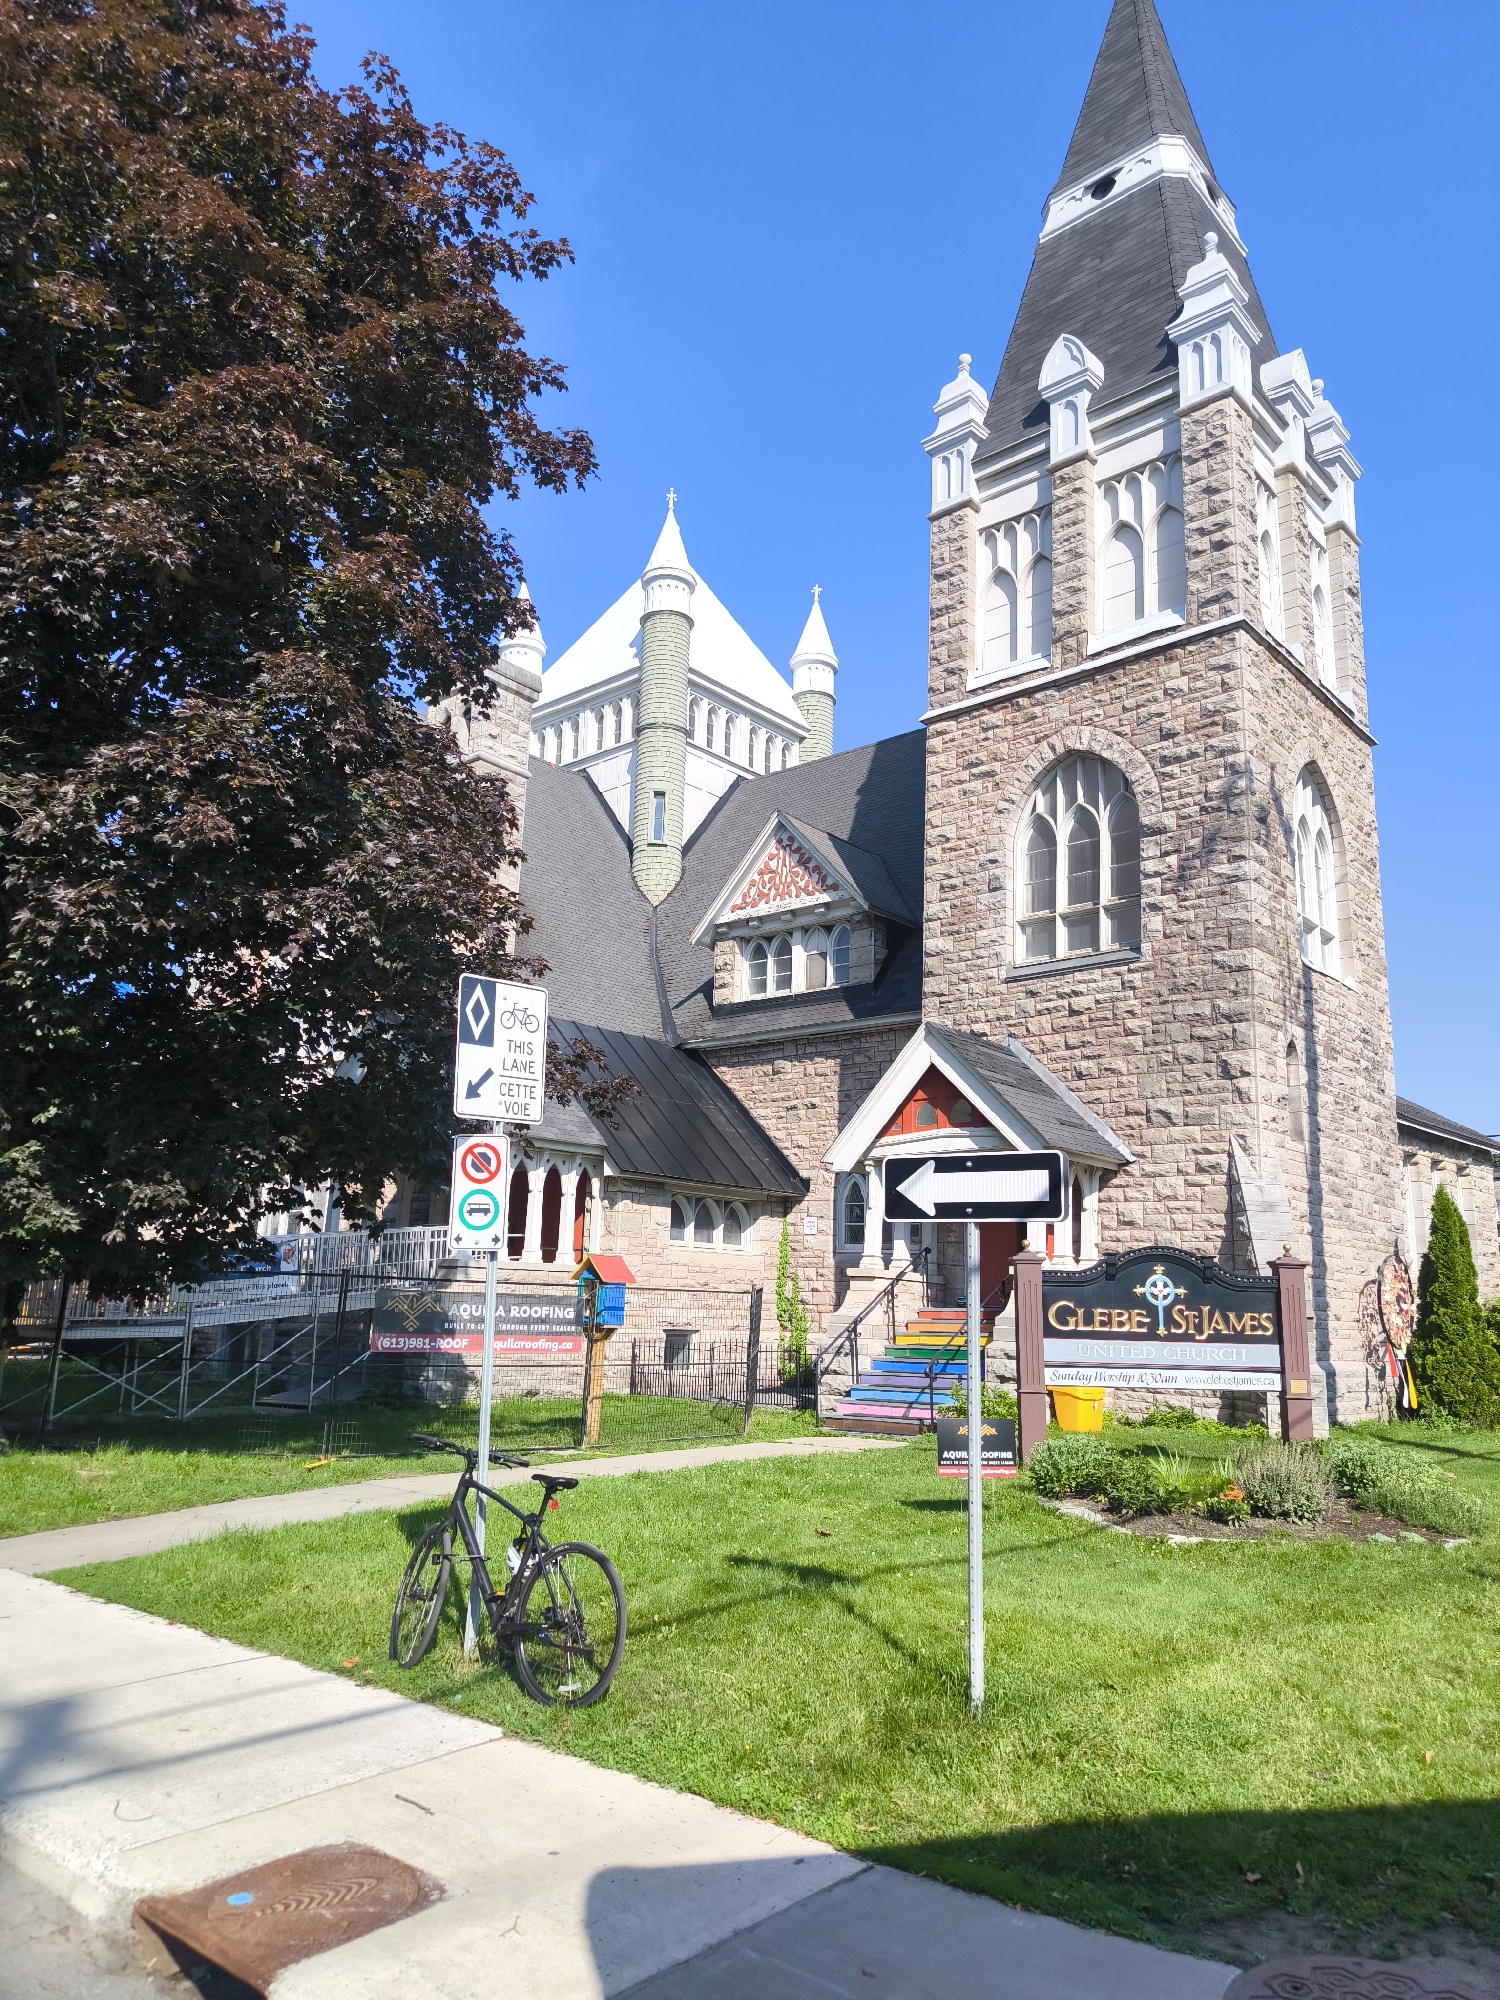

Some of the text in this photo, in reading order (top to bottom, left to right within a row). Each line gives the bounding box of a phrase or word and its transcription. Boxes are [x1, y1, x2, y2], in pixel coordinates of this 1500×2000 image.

[507, 1039, 533, 1056] THIS
[502, 1057, 535, 1074] LANE
[499, 1082, 536, 1100] CETTE
[504, 1100, 531, 1117] VOIE
[448, 1303, 575, 1319] AQUIA ROOFING
[377, 1337, 573, 1352] (613)981-ROOF quilaroofing.ca
[1077, 1343, 1247, 1361] UNITED CHURCH
[1050, 1370, 1092, 1385] Sunday
[1094, 1371, 1135, 1385] Worship
[942, 1450, 1013, 1459] AQUIL OOFING
